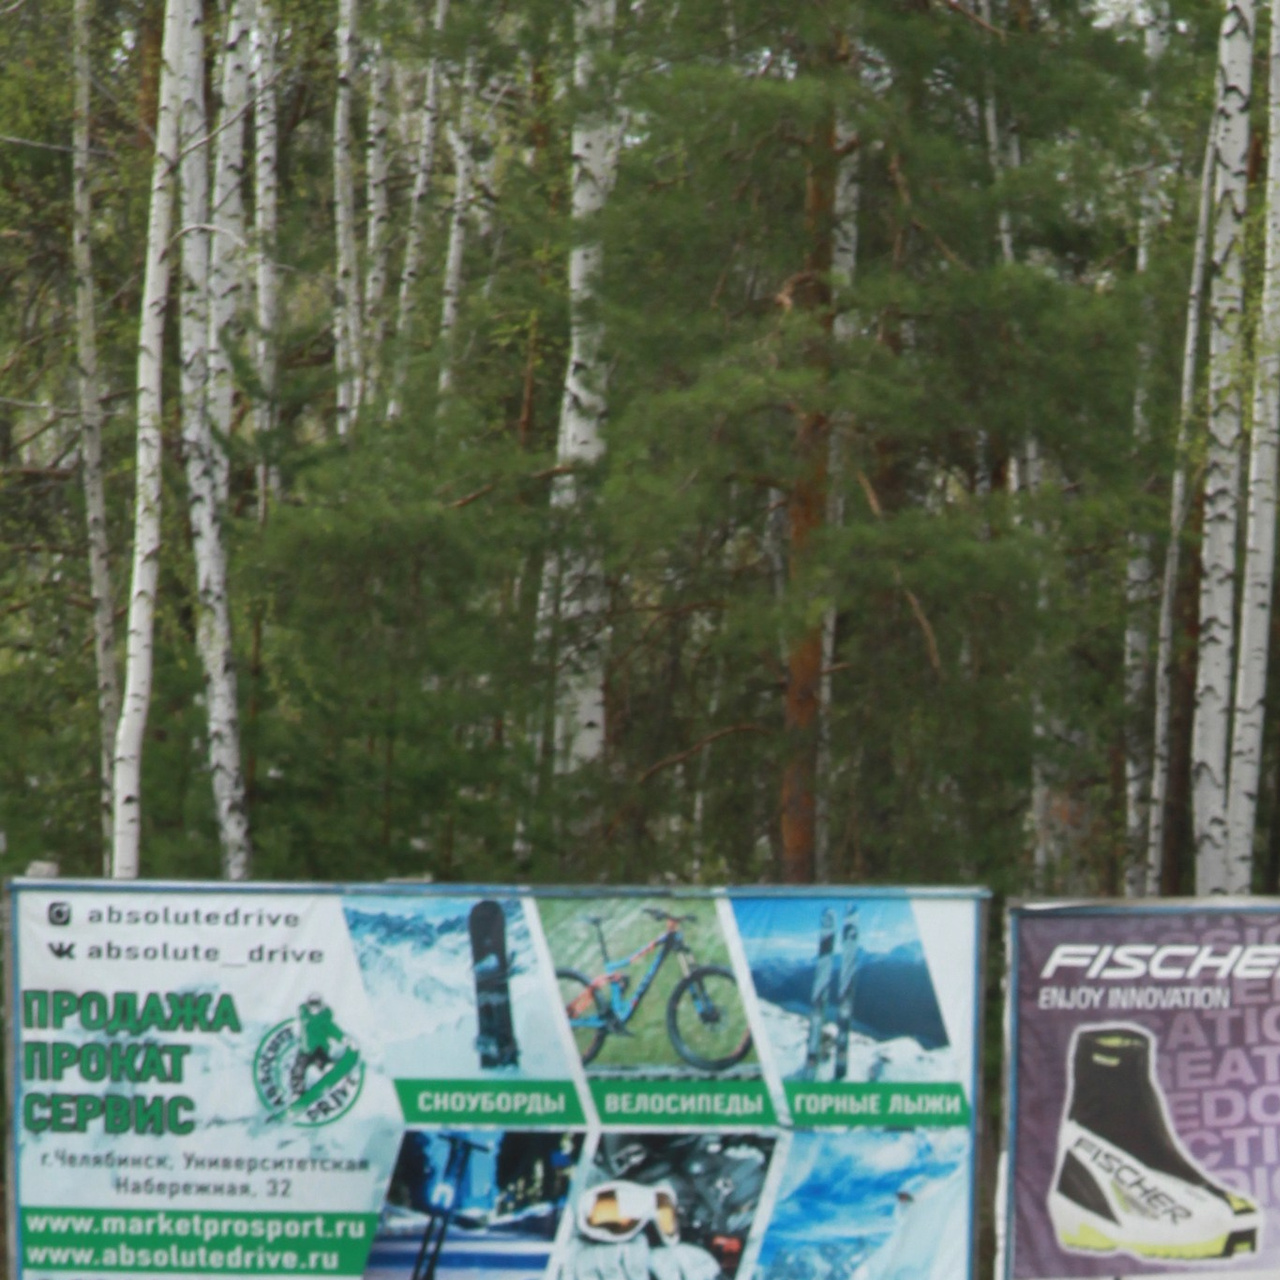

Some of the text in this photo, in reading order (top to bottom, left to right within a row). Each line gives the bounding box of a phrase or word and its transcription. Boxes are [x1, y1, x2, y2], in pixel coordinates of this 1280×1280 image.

[88, 905, 300, 927] absolutedrive
[1038, 987, 1232, 1010] ENJOY INNOVATION
[22, 989, 242, 1036] ПРОДАЖА
[22, 1041, 193, 1083] ПРОКАТ
[23, 1092, 196, 1136] СЕРВИС
[417, 1091, 566, 1115] СНОУБОРДЫ
[605, 1093, 764, 1117] ВЕЛОСИПЕДЫ
[795, 1093, 962, 1115] ГОРНЫЕ ЛЫЖИ
[183, 1152, 370, 1174] Университетская
[266, 1179, 292, 1197] 32
[1074, 1138, 1192, 1225] FISCHER
[26, 1213, 366, 1242] www.marketprosport.ru
[27, 1243, 339, 1270] www.absolutedrive.ru
